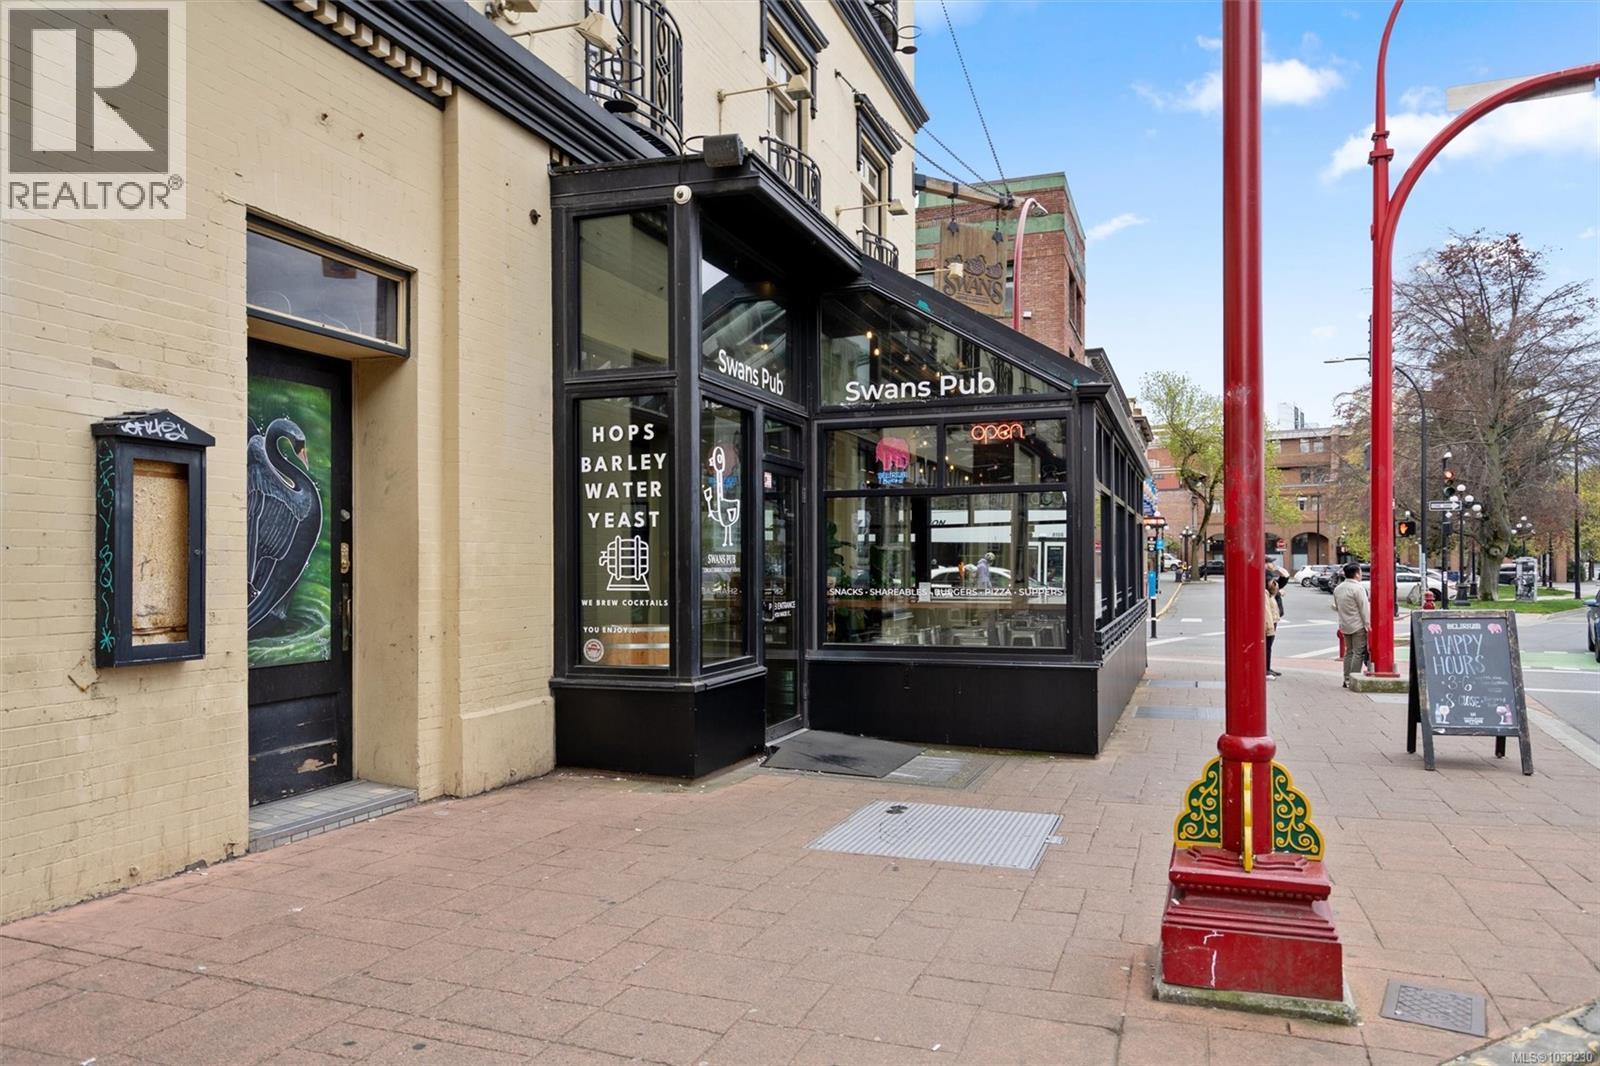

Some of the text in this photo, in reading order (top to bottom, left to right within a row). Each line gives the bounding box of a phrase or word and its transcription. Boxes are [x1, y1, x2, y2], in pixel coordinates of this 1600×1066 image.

[718, 349, 784, 396] Swans Pub
[845, 372, 995, 402] Swans Pub
[592, 423, 655, 443] HOPS
[971, 422, 1025, 445] open
[581, 453, 667, 473] BARLEY
[585, 481, 662, 499] WATER
[588, 511, 660, 529] YEAST
[829, 588, 1064, 597] SNACKS SHAREABLES BURGERS PIZZA SUPPERS
[581, 599, 669, 607] WE BREW COCKTAILS
[583, 626, 600, 634] YOU
[1434, 633, 1483, 656] HAPPY
[1432, 655, 1486, 675] HOURS
